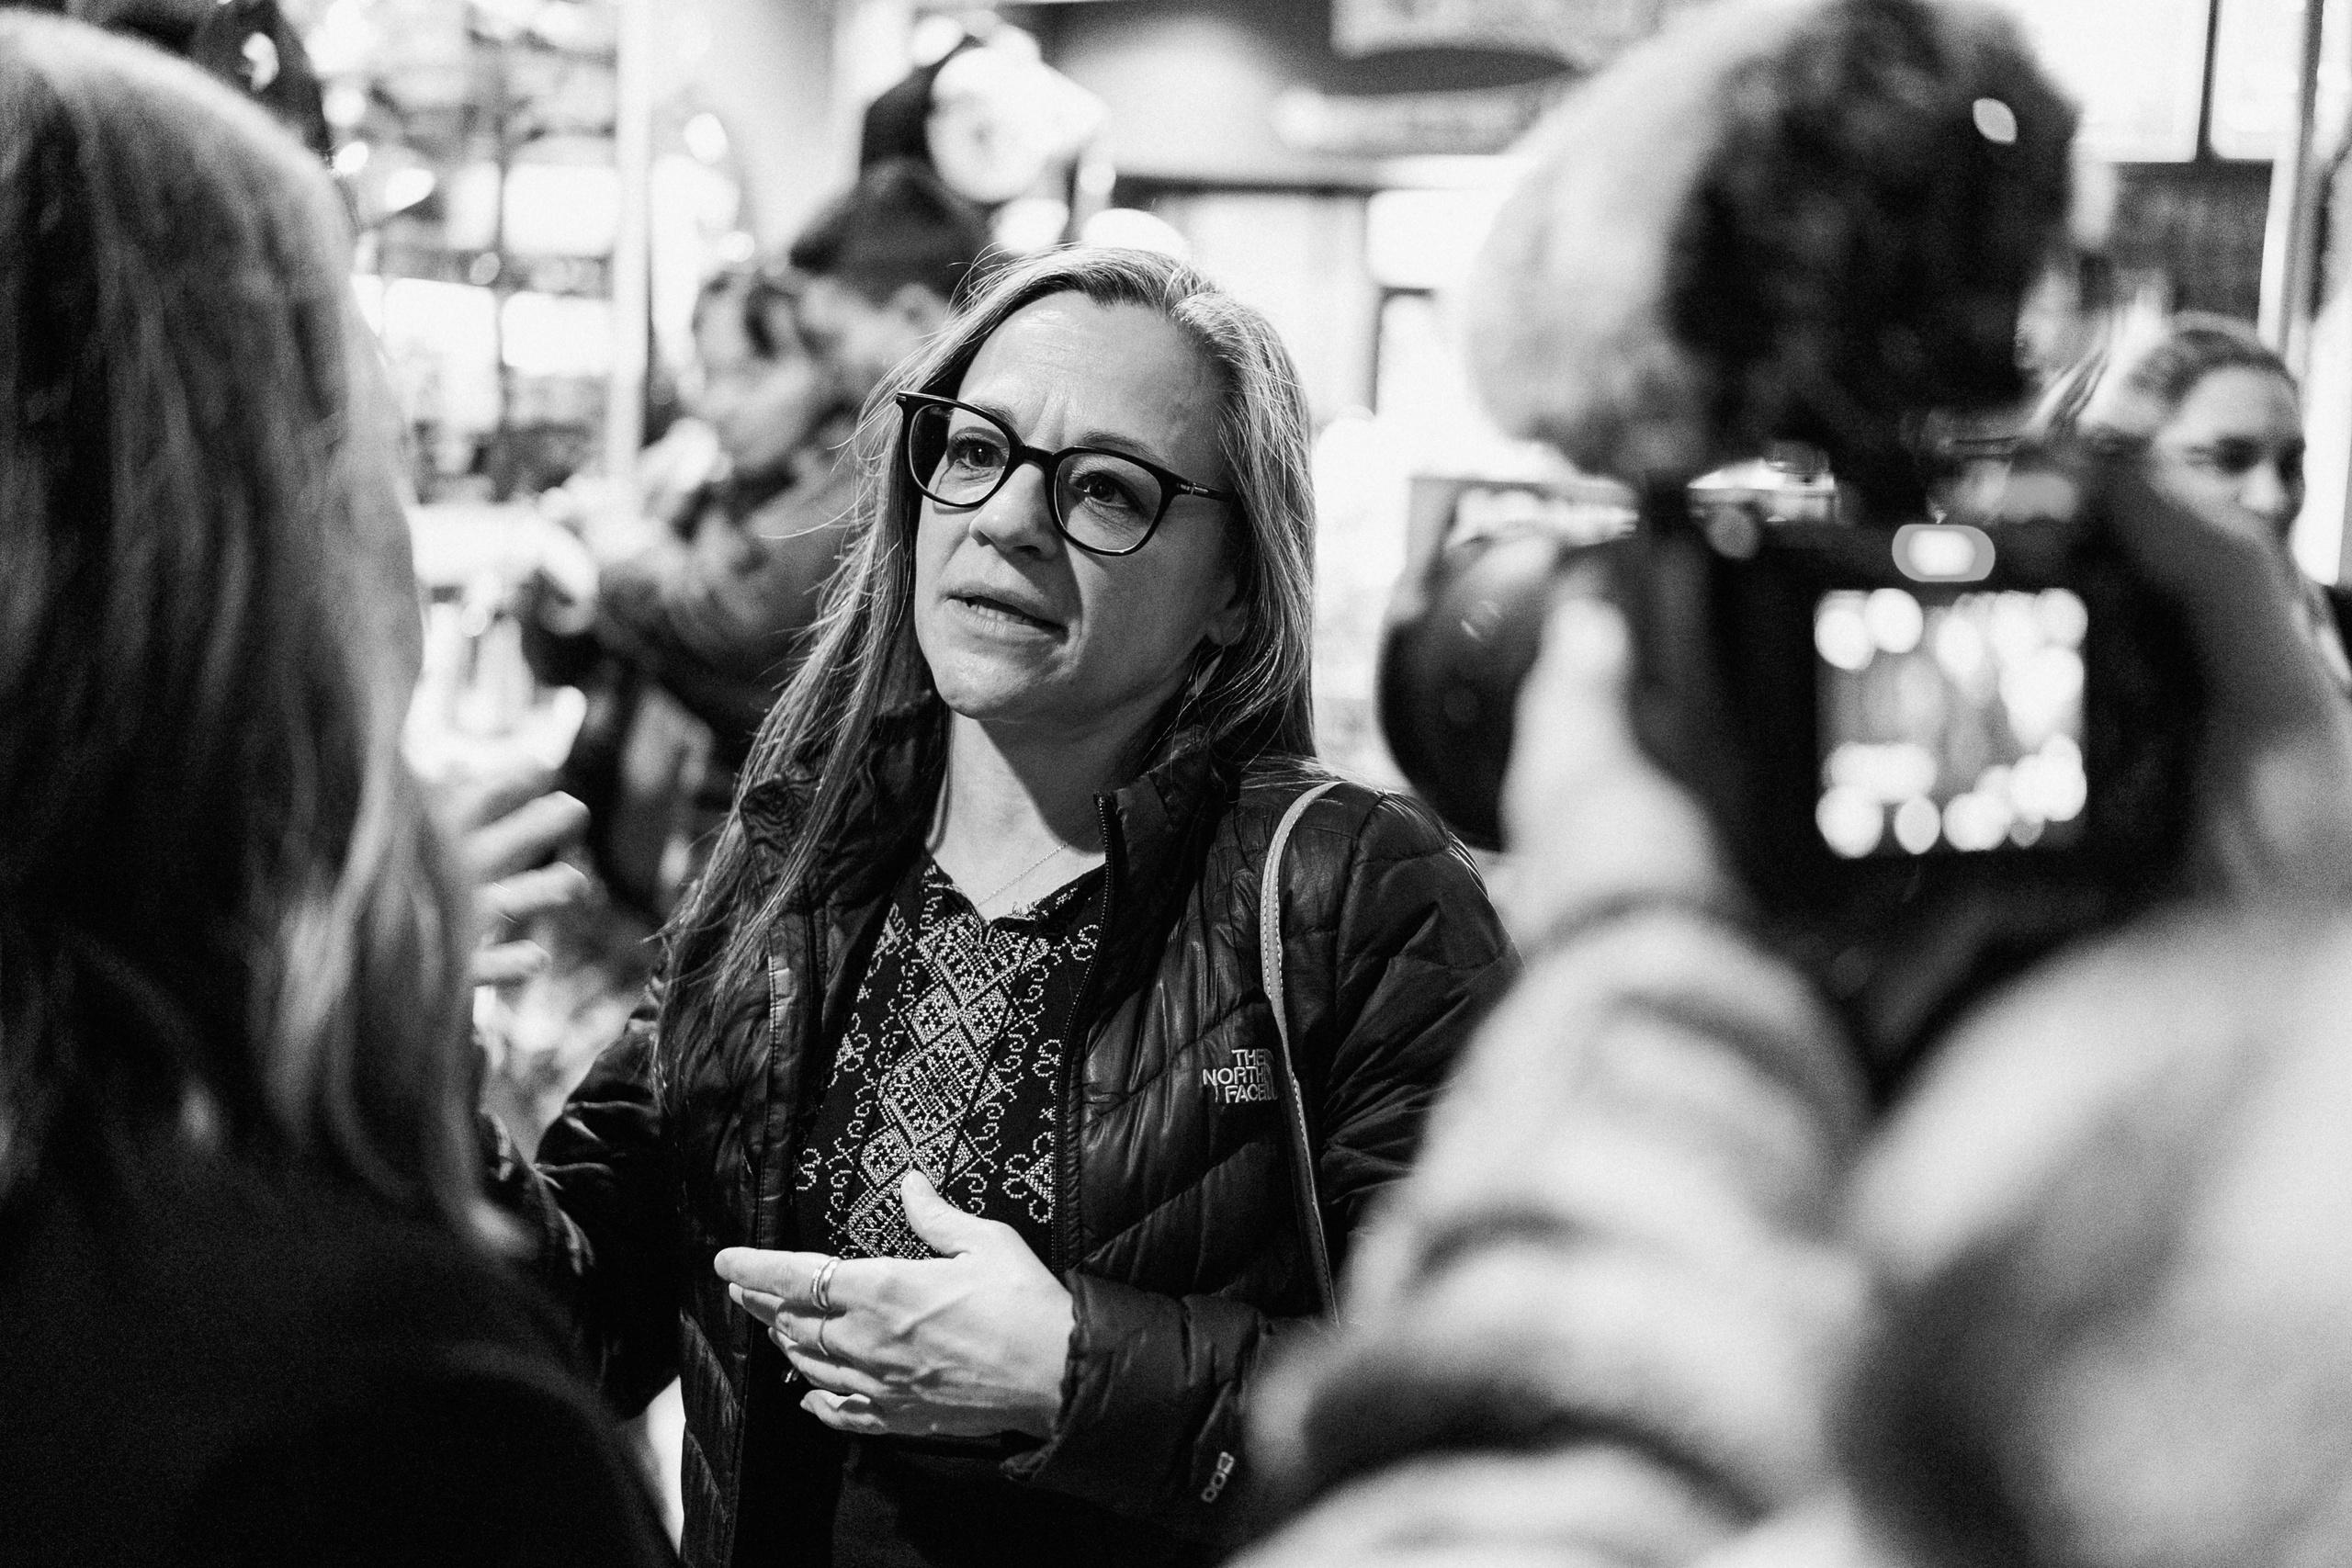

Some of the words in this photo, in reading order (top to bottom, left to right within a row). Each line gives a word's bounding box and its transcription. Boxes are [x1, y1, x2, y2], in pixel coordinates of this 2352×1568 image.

[1231, 1049, 1265, 1066] THE
[1203, 1066, 1264, 1086] NORTH
[1225, 1084, 1266, 1103] FACE
